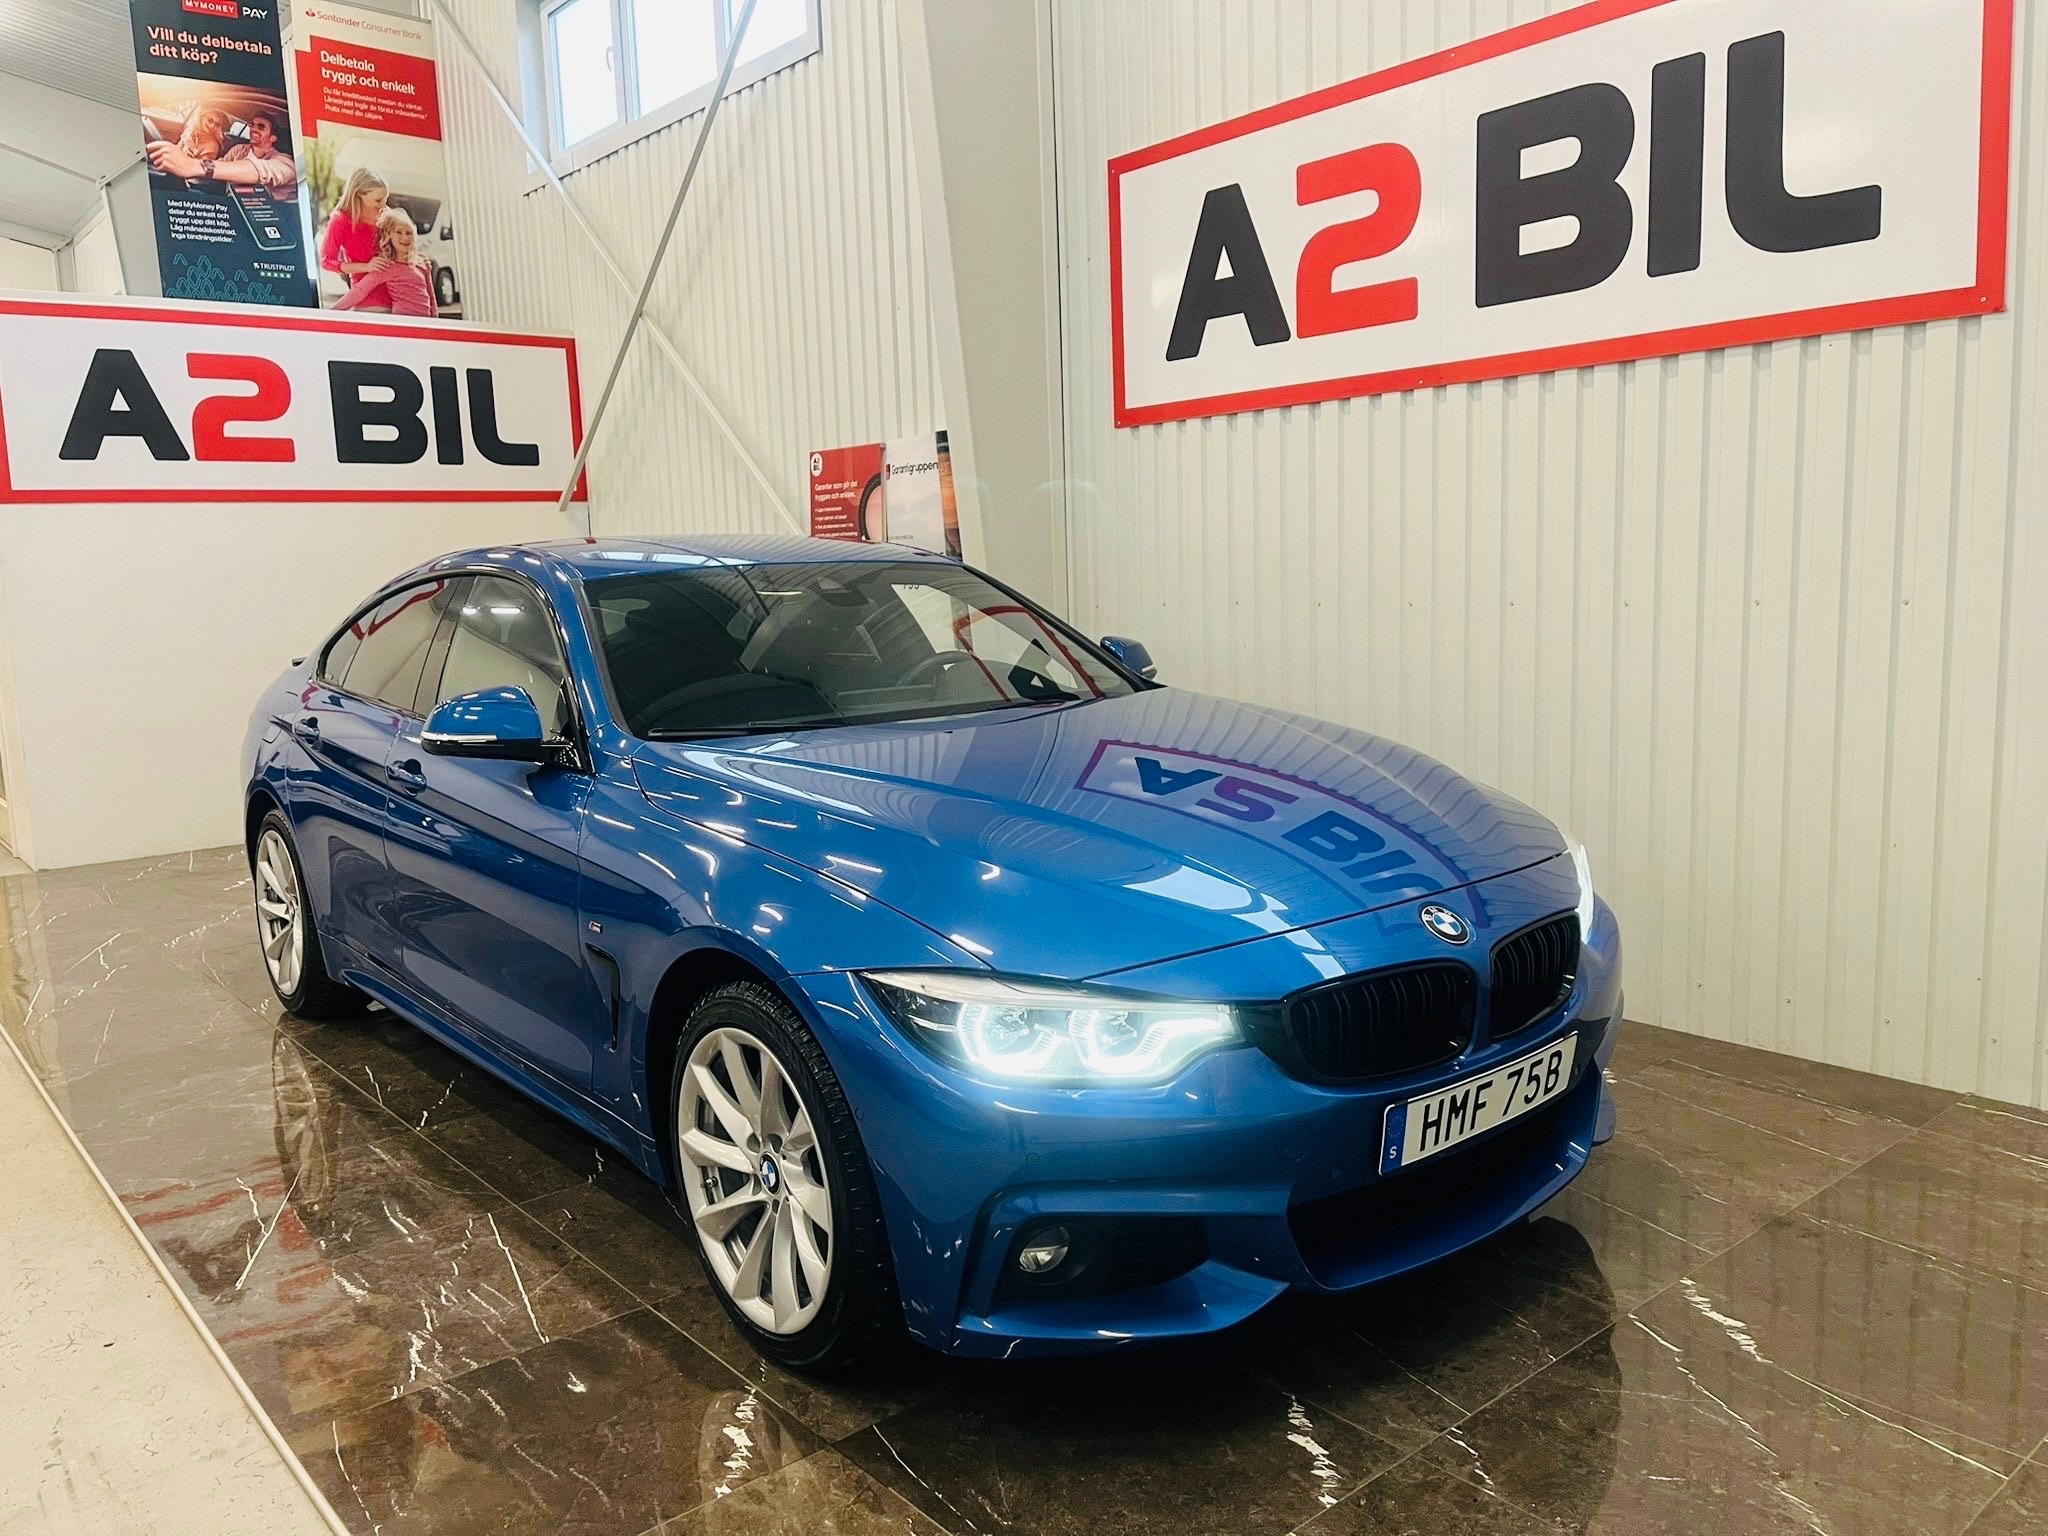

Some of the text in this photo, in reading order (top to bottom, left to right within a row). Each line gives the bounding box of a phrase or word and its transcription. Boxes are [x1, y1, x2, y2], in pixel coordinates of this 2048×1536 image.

[184, 0, 268, 19] MYMONEY PAY
[317, 10, 422, 41] Santander Consumer Bank
[147, 25, 272, 55] Vill du delbetala
[149, 43, 218, 64] ditt köp?
[320, 50, 375, 72] Delbetala
[321, 66, 416, 95] tryggt och enkelt
[323, 87, 332, 95] Du
[167, 199, 228, 212] Med MyMoney Pay
[1165, 29, 1883, 363] A2 BIL
[169, 216, 190, 224] tryggt
[191, 218, 204, 226] upp
[204, 218, 216, 226] ditt
[170, 223, 183, 232] Låg
[260, 263, 295, 272] TRUSTPILOT
[58, 348, 540, 466] A2 BIL
[892, 462, 939, 476] Garantigruppen
[1419, 1050, 1563, 1151] HMF 75B
[1389, 1146, 1397, 1158] S
